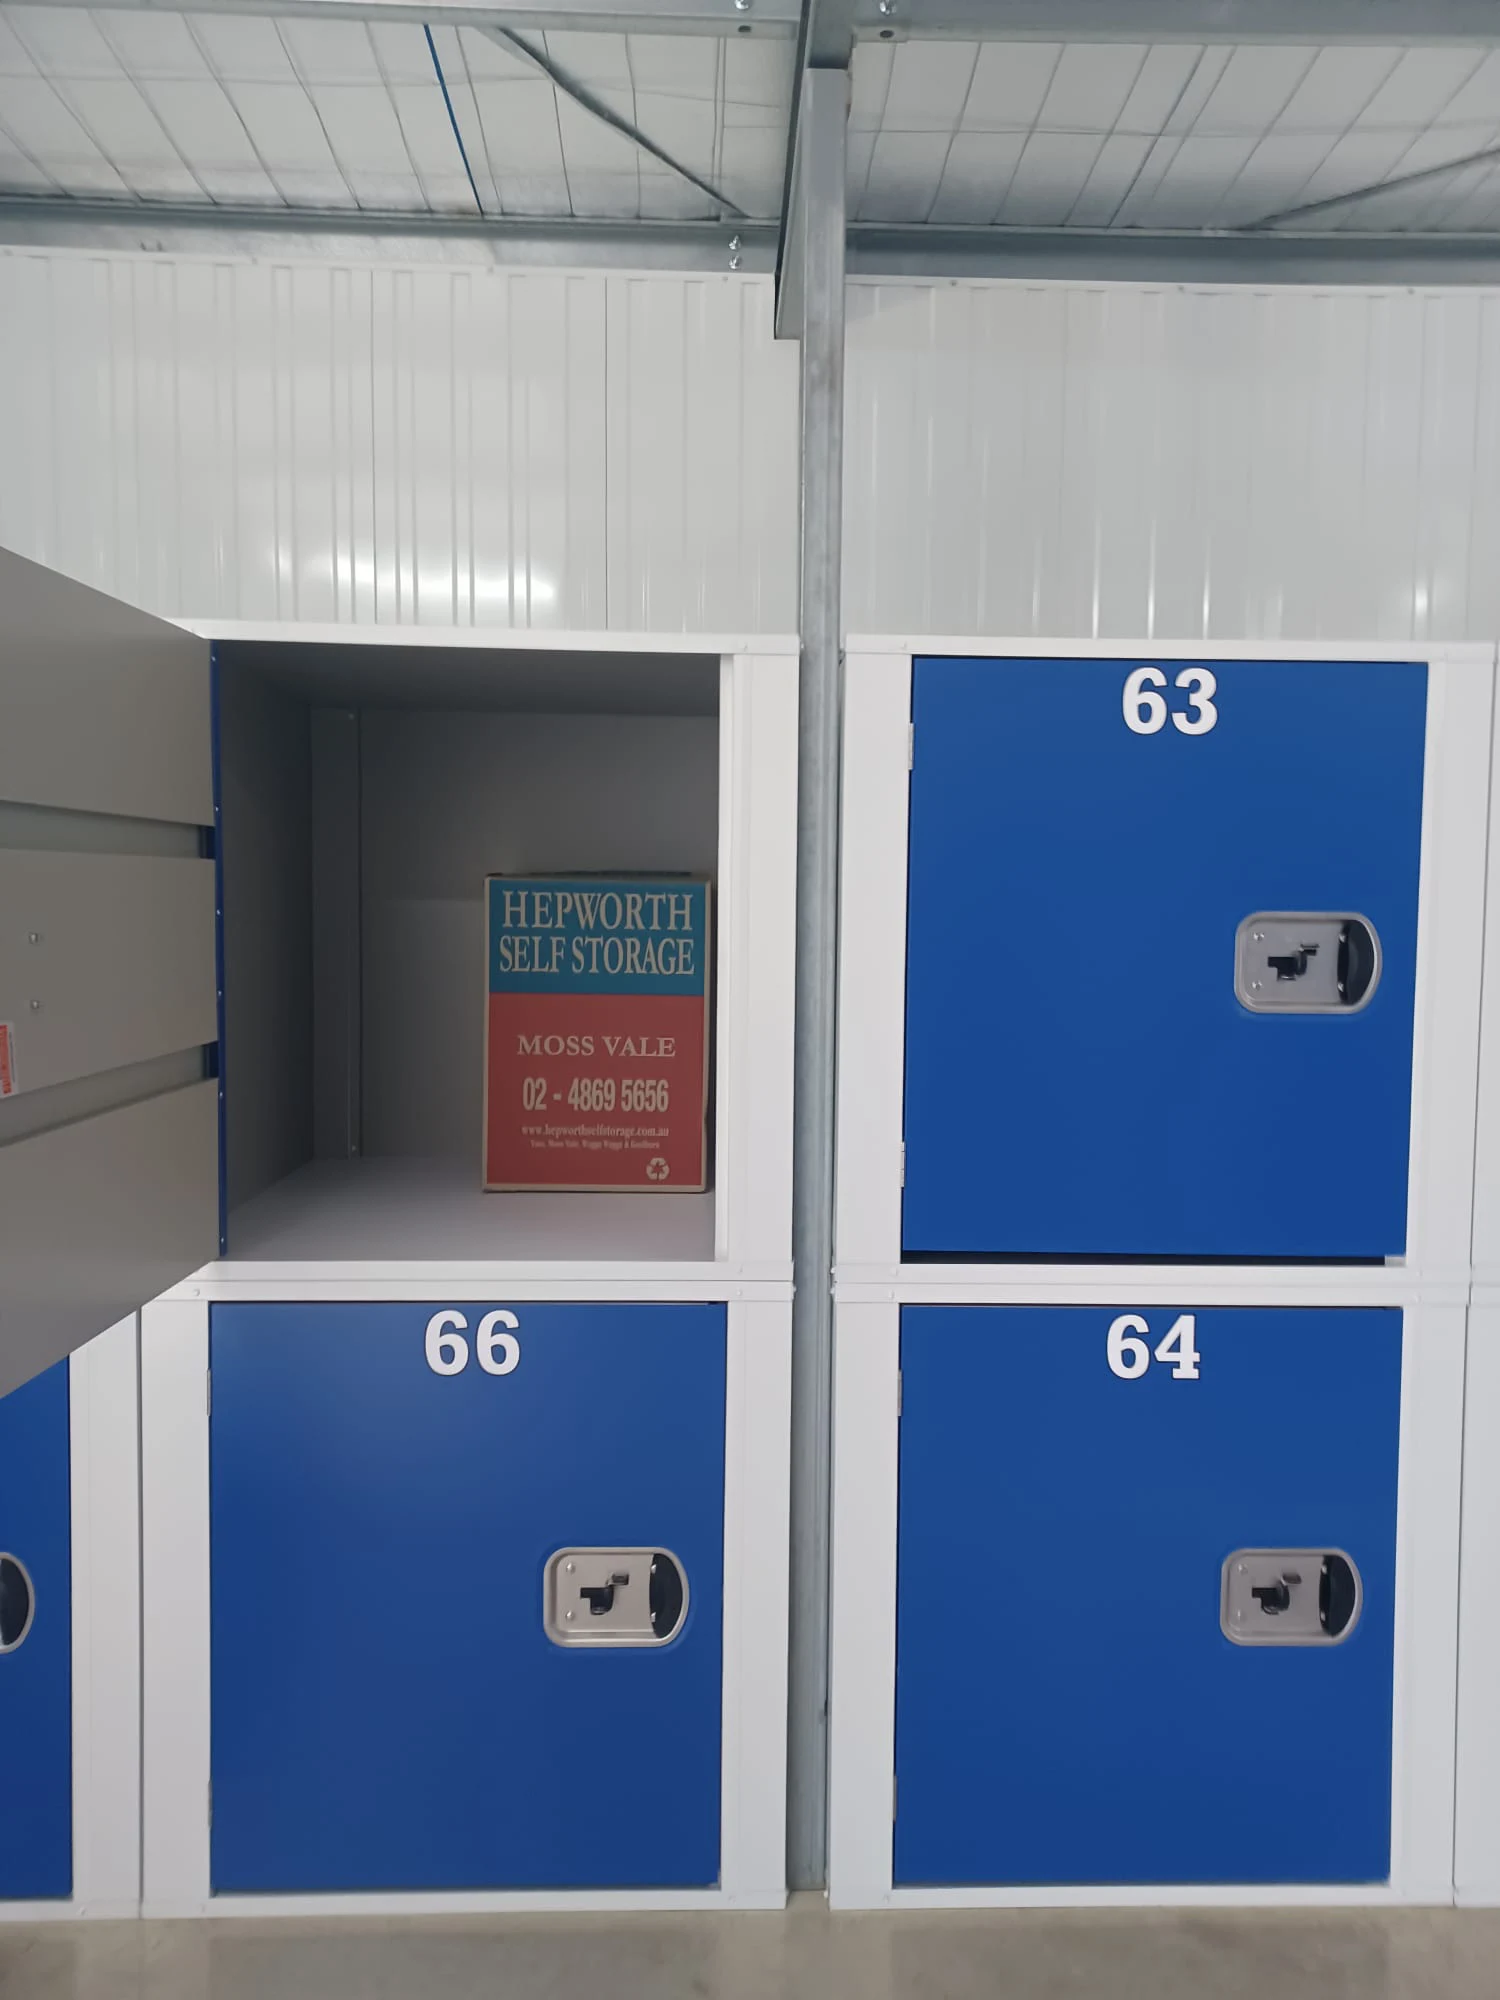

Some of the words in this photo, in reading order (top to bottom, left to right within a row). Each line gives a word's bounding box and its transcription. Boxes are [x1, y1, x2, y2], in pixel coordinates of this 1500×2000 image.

[1122, 667, 1218, 735] 63
[502, 889, 693, 931] HEPWORTH
[499, 935, 566, 973] SELF
[572, 936, 695, 975] STORAGE
[517, 1035, 594, 1056] MOSS
[602, 1036, 676, 1057] VALE
[522, 1077, 547, 1111] 02
[567, 1077, 616, 1112] 4869
[621, 1079, 669, 1113] 5656
[521, 1124, 669, 1142] www.hepworthselfstorage.com.au
[425, 1309, 520, 1376] 66
[1107, 1314, 1201, 1379] 64
